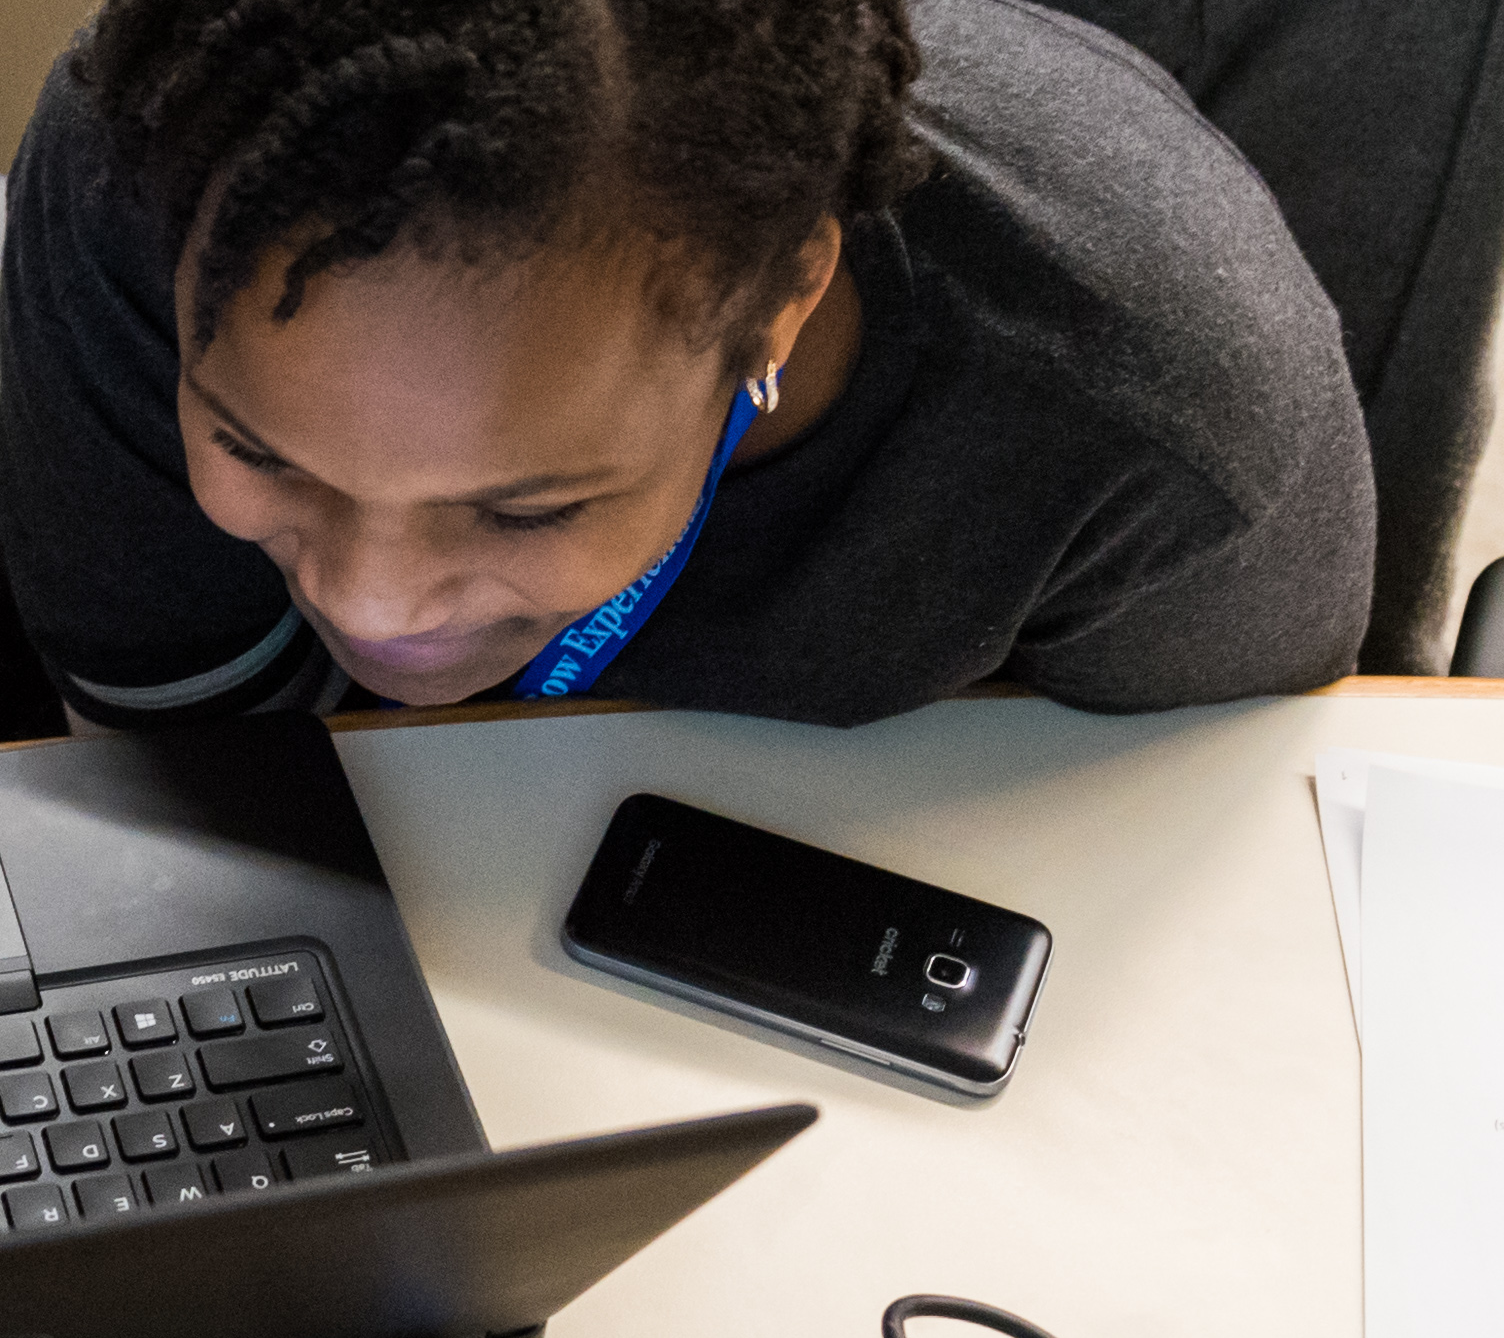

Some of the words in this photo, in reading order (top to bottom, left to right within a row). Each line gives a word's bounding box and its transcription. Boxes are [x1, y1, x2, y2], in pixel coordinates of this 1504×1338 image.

[870, 927, 900, 977] cricket
[228, 961, 299, 982] LATITUDE
[192, 973, 226, 986] E5450
[292, 1001, 314, 1014] Ctrl
[220, 1013, 236, 1024] Fn
[84, 1035, 100, 1045] Alt
[306, 1053, 334, 1065] Shift
[296, 1111, 324, 1125] Lock
[326, 1106, 354, 1119] Caps
